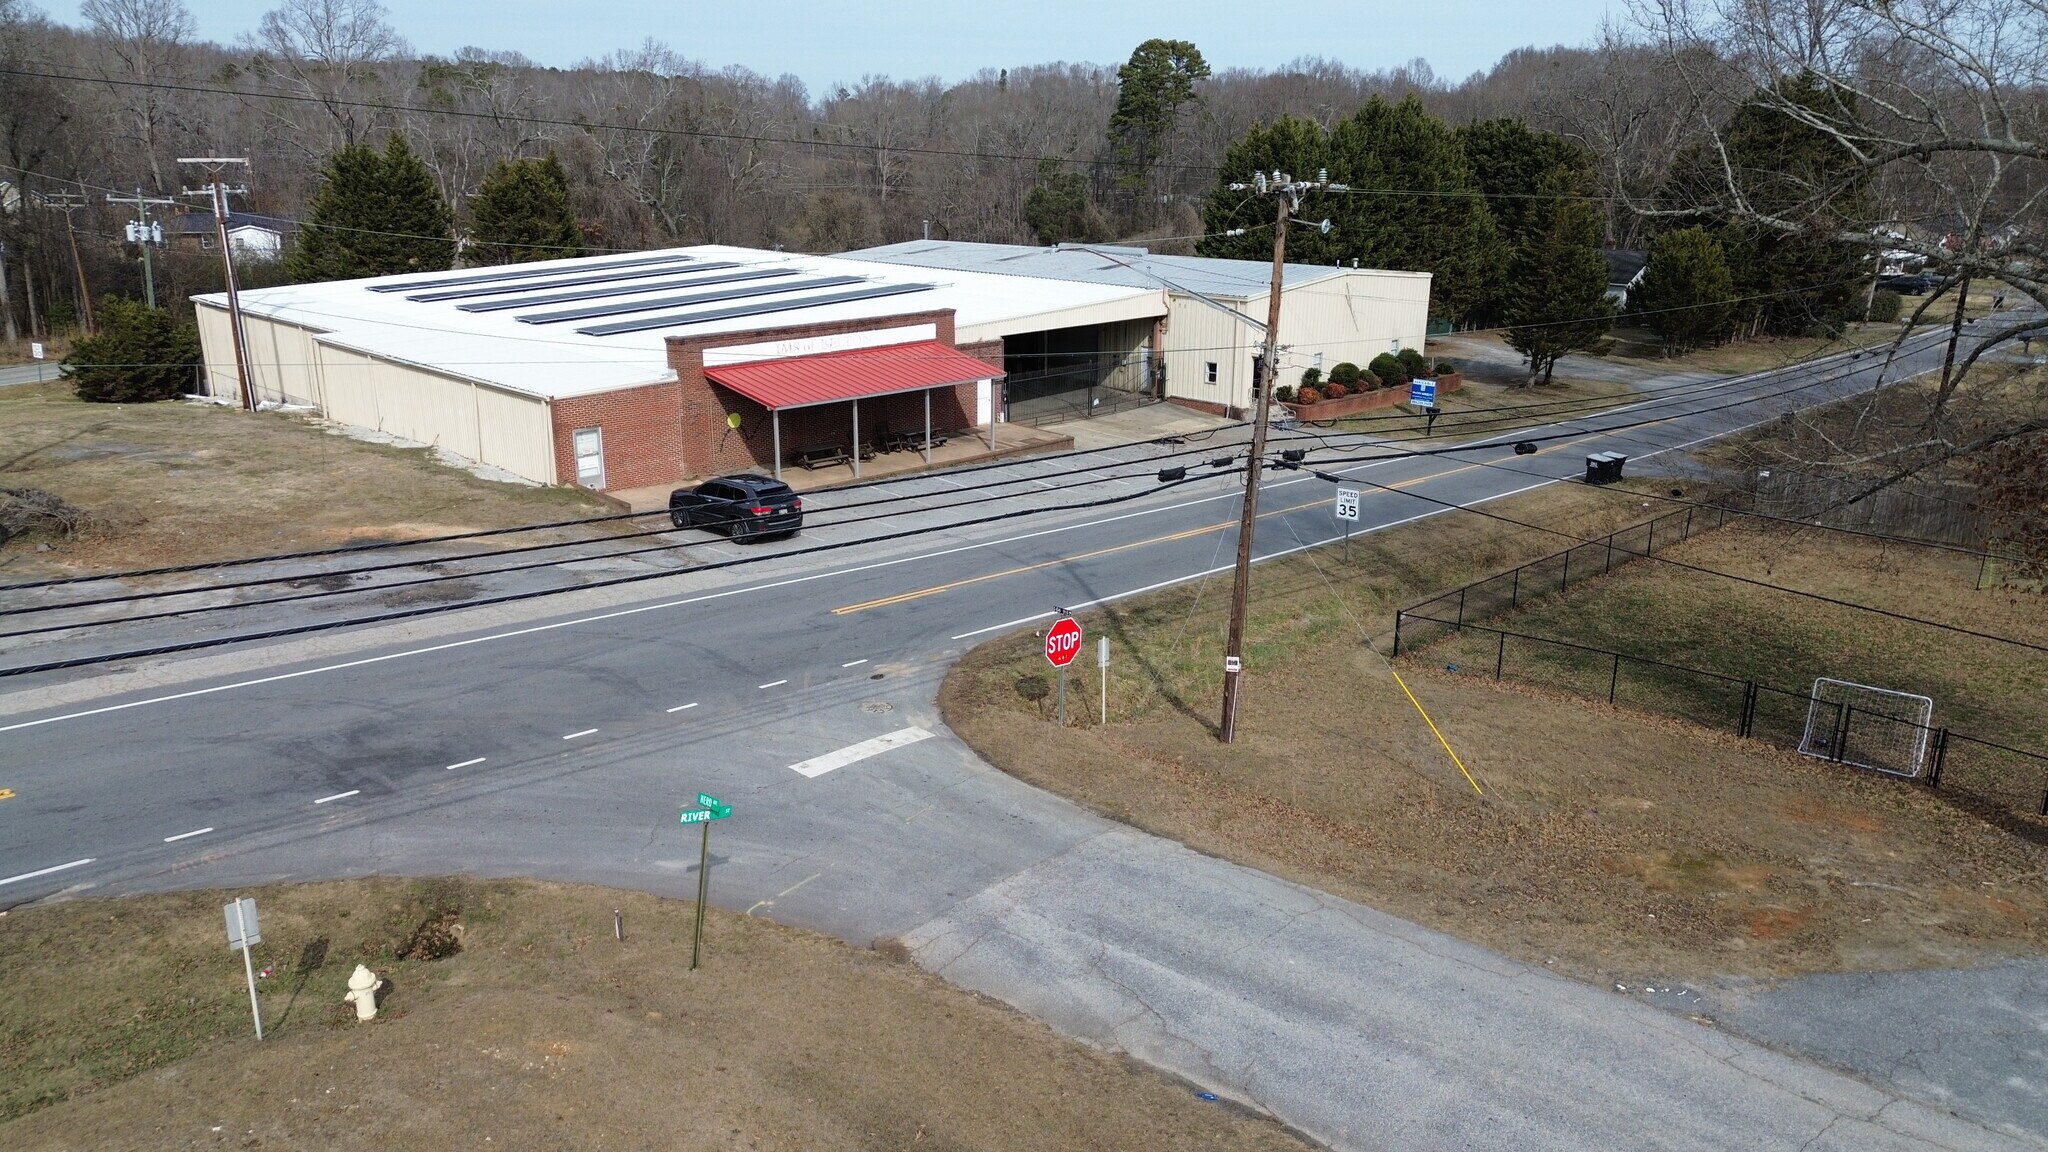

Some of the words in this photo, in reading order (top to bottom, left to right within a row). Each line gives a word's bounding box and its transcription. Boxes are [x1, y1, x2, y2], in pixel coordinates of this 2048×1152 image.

[1339, 490, 1358, 499] SPEED
[1339, 504, 1357, 517] 35
[1048, 631, 1079, 654] STOP
[680, 810, 711, 823] RIVER
